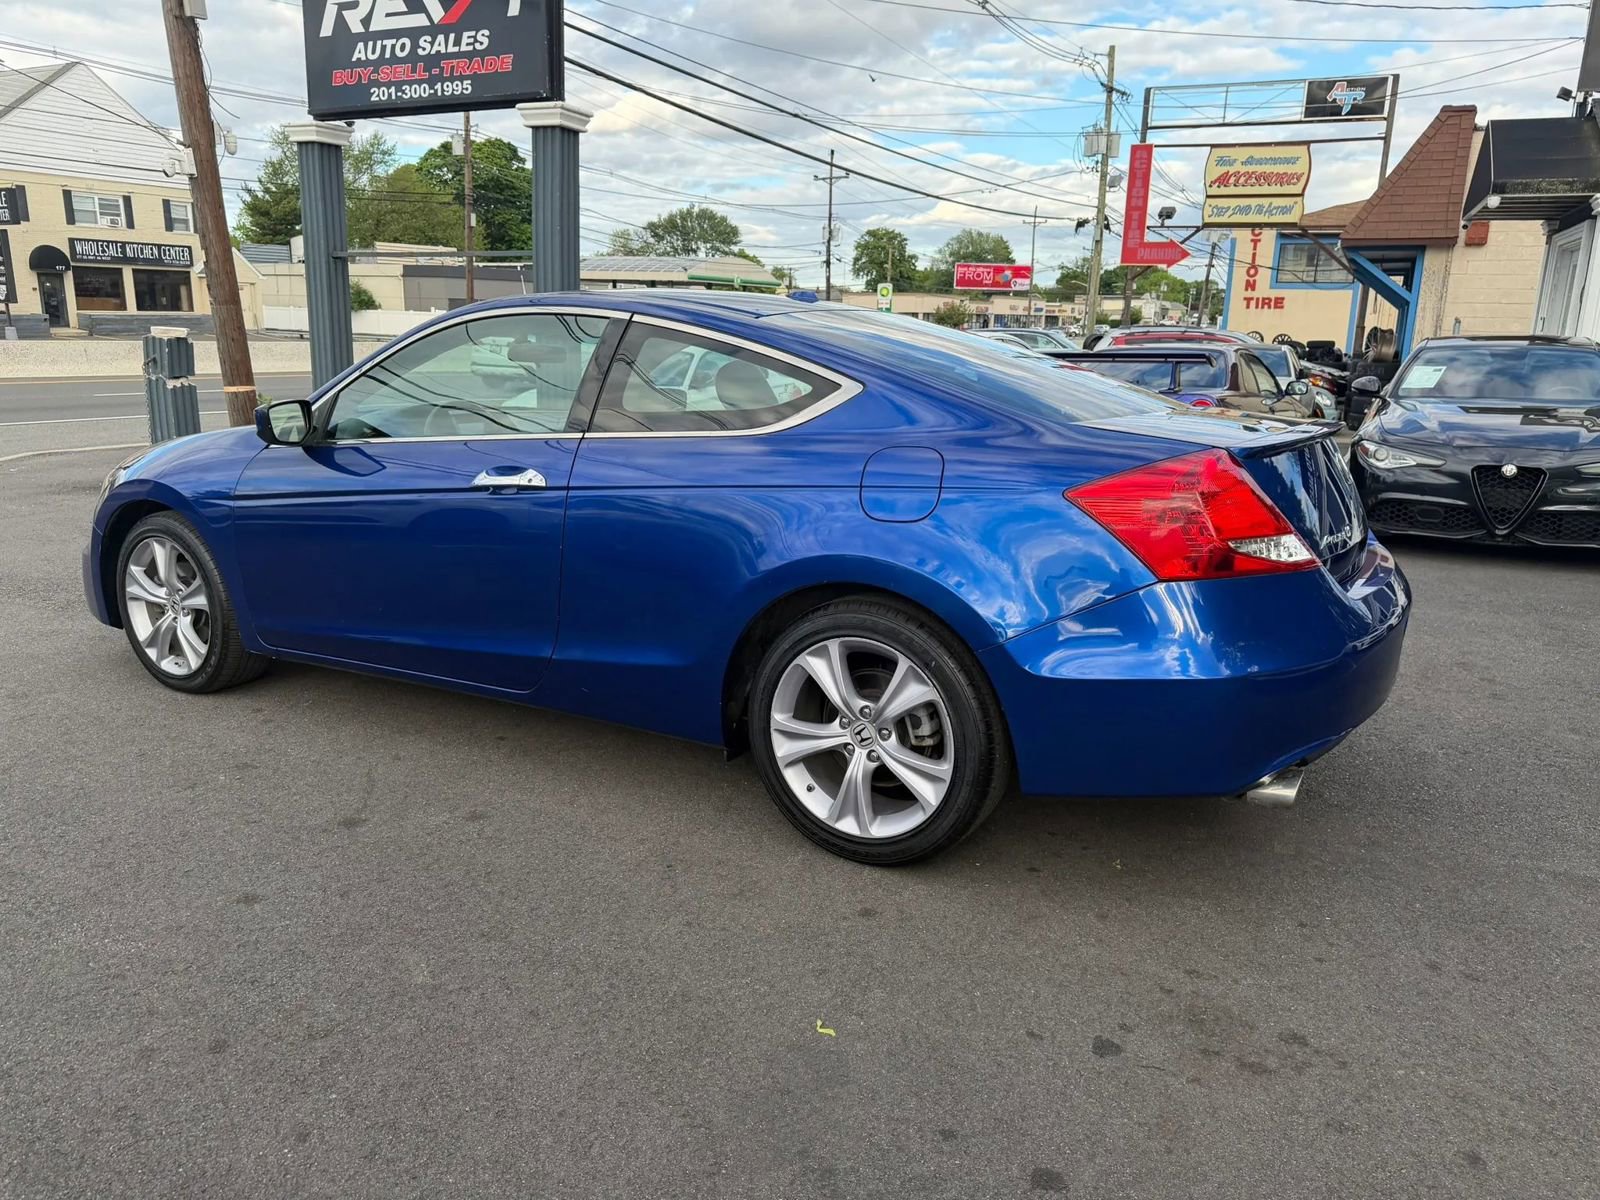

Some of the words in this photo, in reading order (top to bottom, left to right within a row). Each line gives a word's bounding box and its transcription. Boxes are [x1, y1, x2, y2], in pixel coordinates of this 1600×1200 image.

[352, 37, 411, 61] AUTO
[417, 30, 490, 55] SALES
[370, 80, 472, 101] 201-300-1995
[1208, 170, 1304, 188] ACCESSORIES
[74, 239, 124, 257] WHOLESALE
[125, 243, 159, 259] KITCHEN
[160, 245, 191, 261] CENTER
[1136, 247, 1181, 260] PARKING
[957, 271, 993, 281] FROM
[1243, 296, 1285, 309] TIRE
